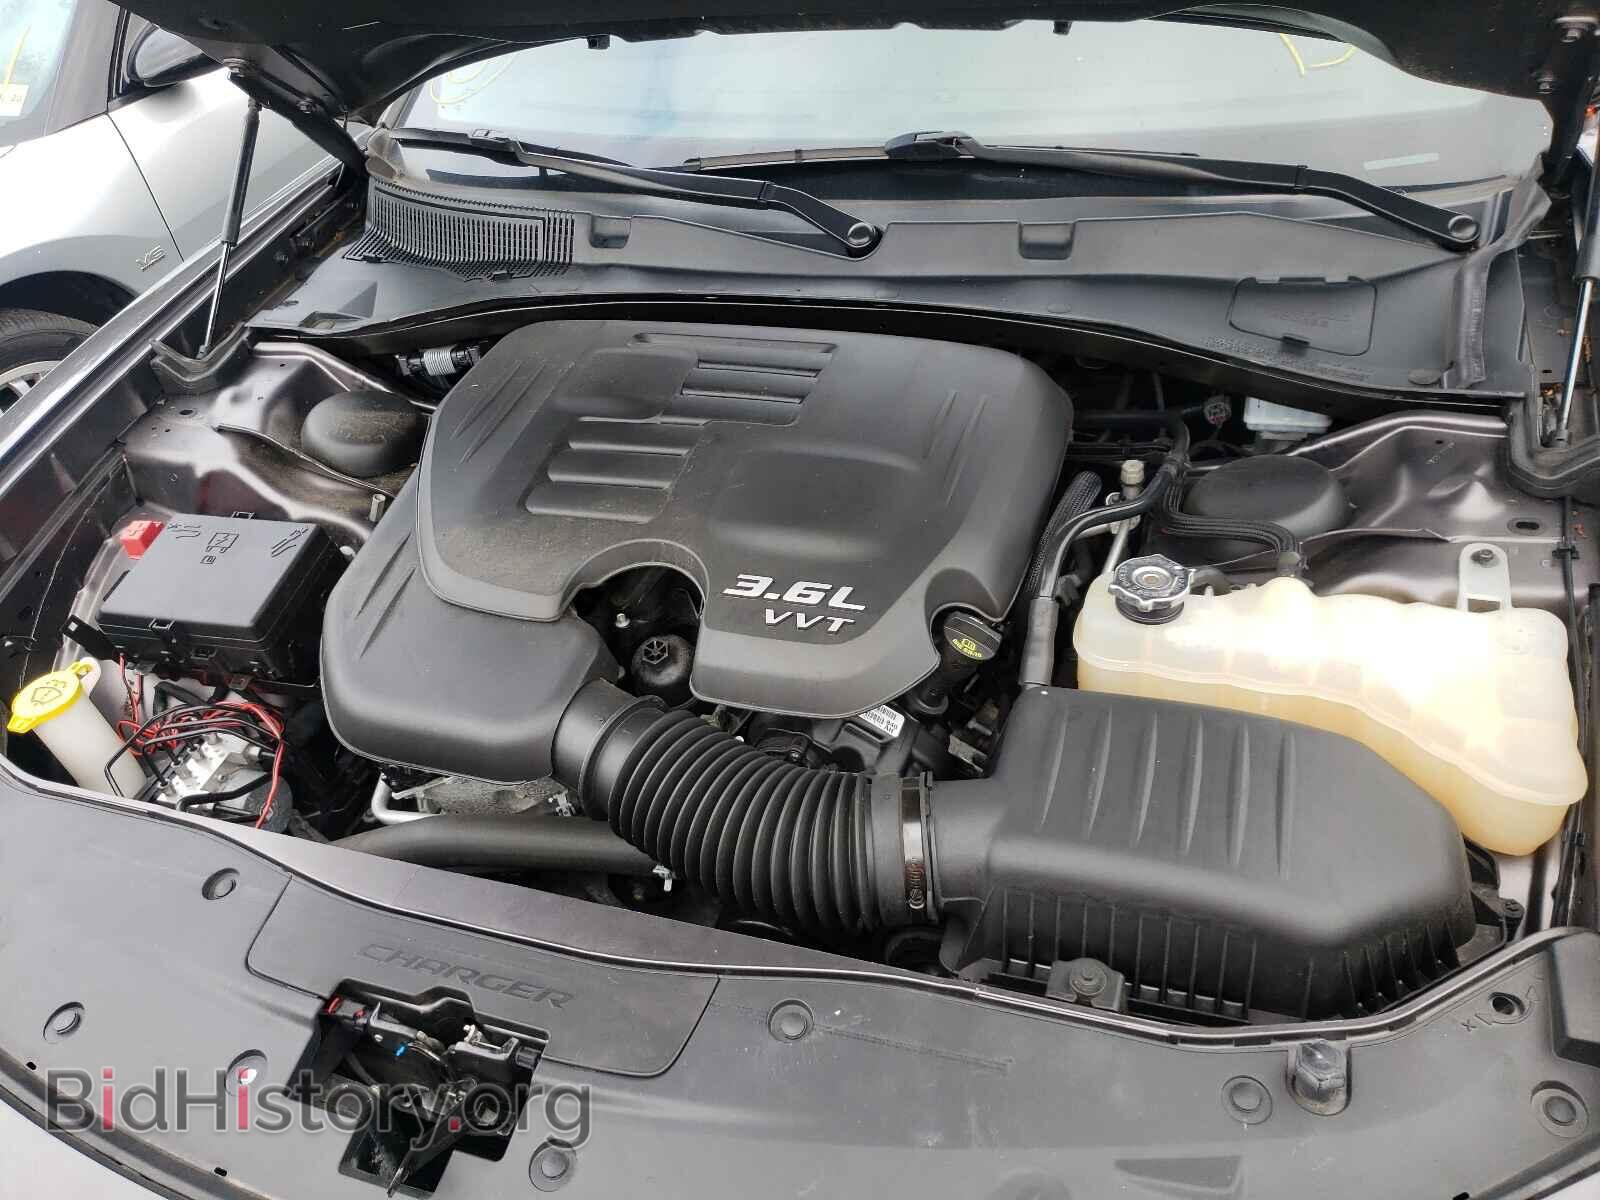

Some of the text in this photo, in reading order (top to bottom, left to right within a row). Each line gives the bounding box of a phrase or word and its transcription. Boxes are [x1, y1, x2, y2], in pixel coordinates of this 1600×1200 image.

[722, 573, 866, 611] 3.6L
[765, 608, 855, 633] VVT
[358, 943, 576, 1009] CHARGER
